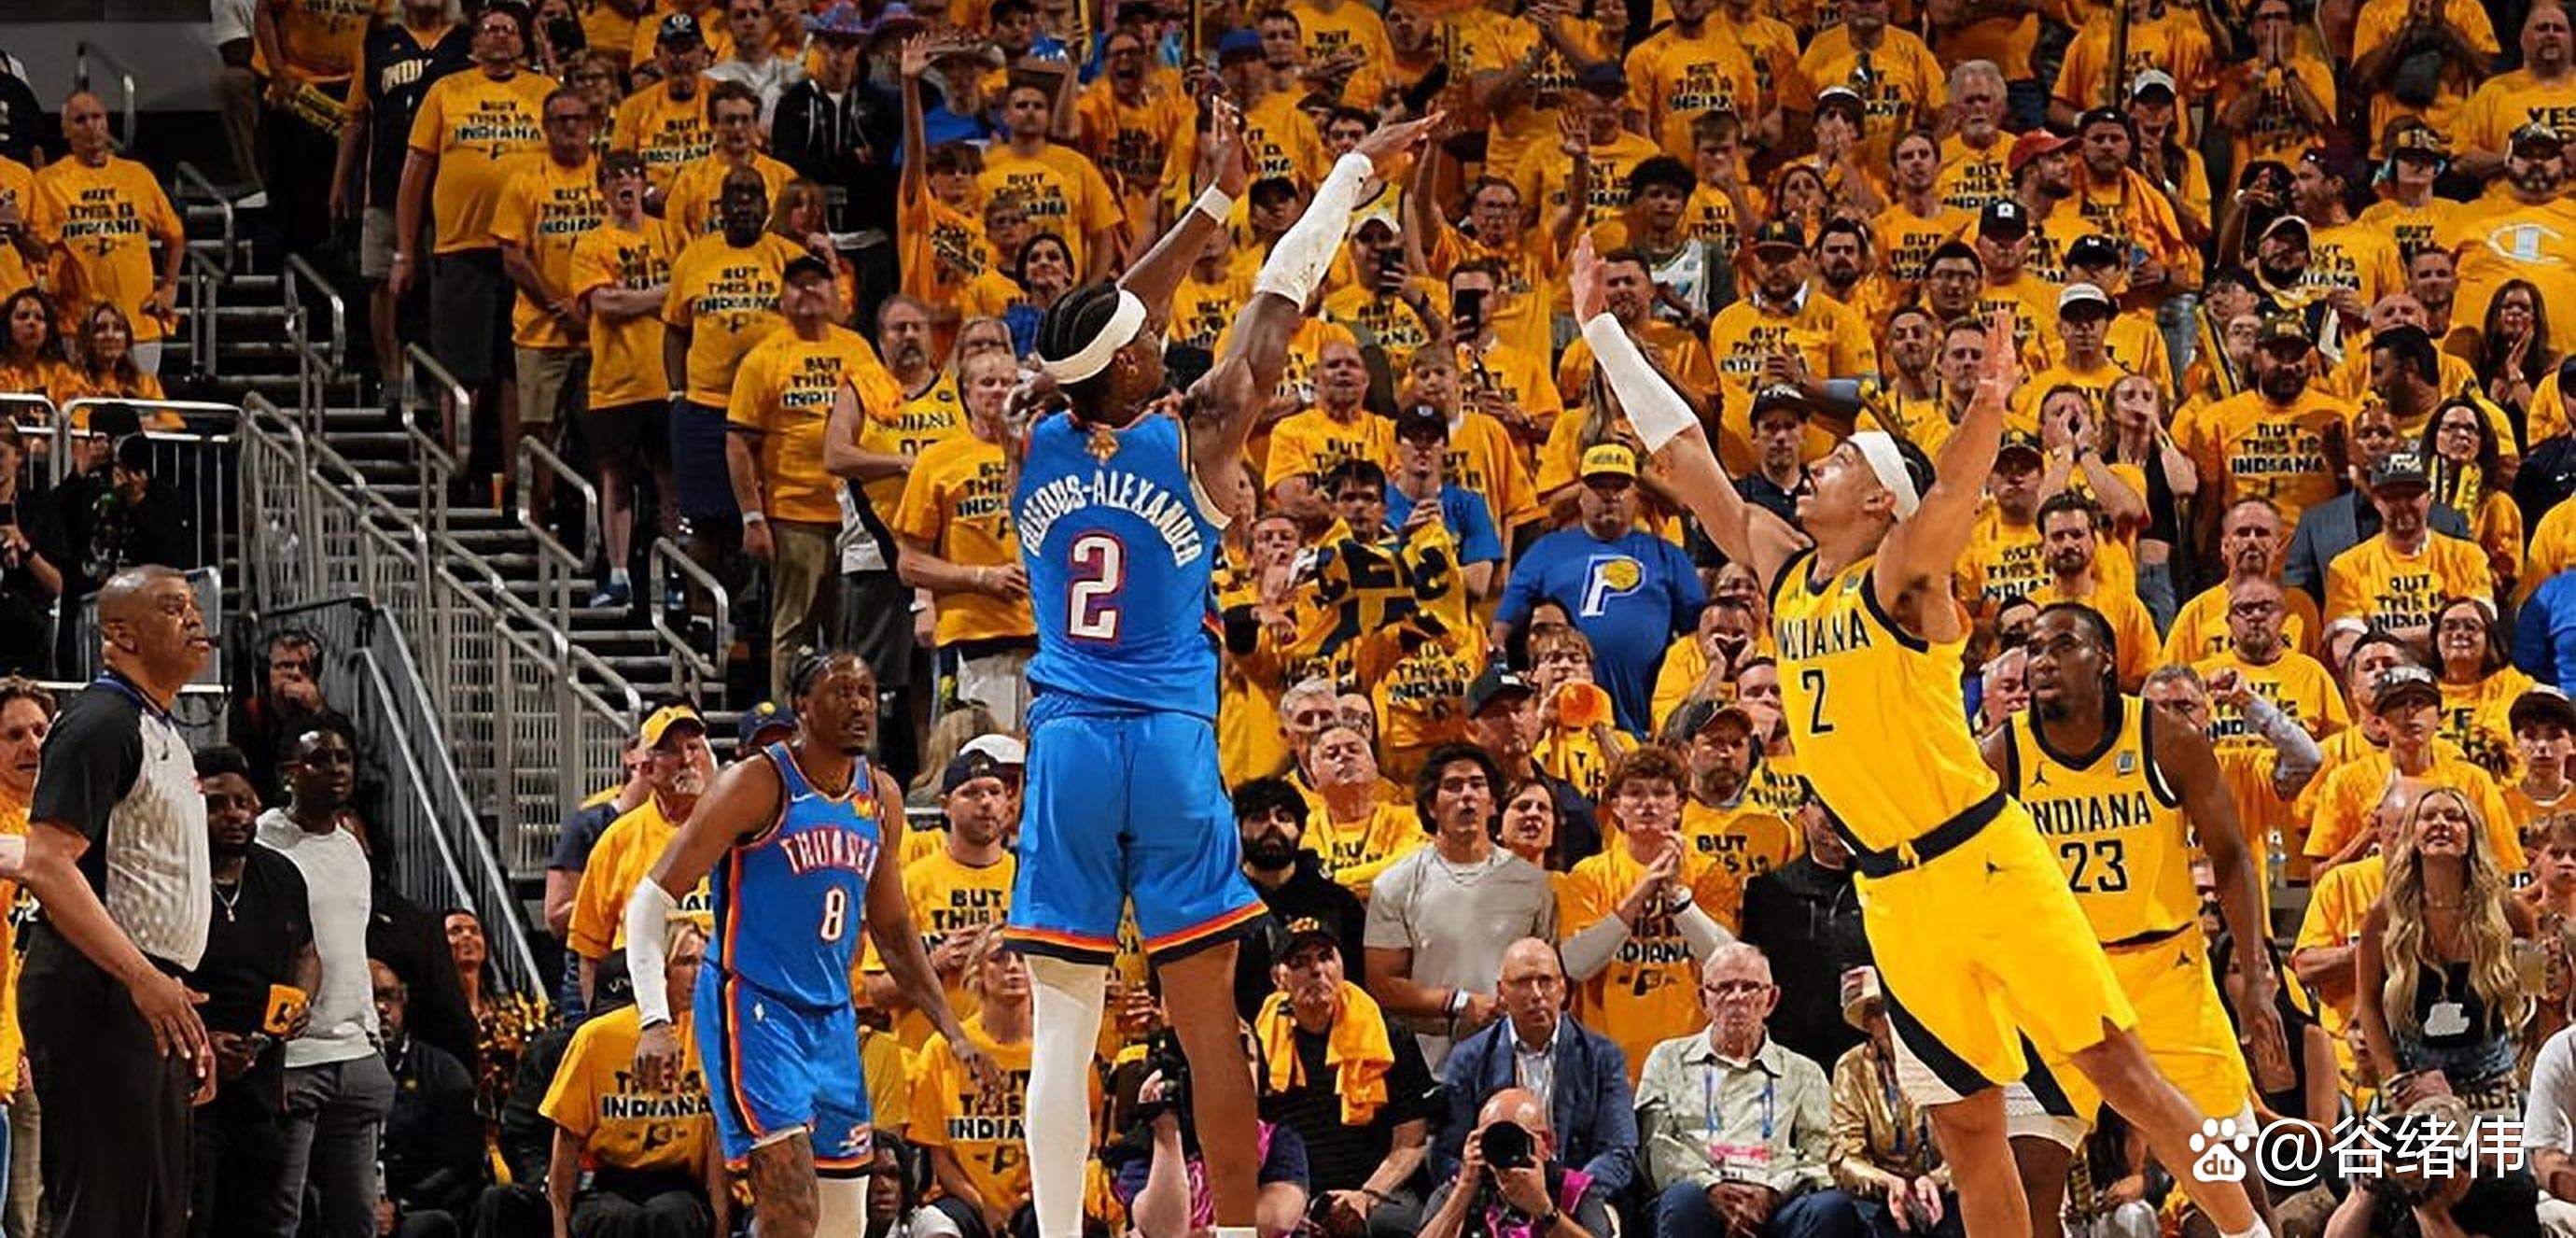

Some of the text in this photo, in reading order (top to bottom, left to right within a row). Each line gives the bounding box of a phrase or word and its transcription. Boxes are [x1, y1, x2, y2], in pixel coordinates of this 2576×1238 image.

[2232, 457, 2324, 474] INDIANA
[1069, 533, 1124, 641] 2
[1802, 668, 1834, 734] 2
[2023, 790, 2152, 838] NDIANA
[1697, 835, 1747, 853] BUT
[2060, 837, 2129, 893] 23
[820, 887, 847, 942] 8
[951, 888, 1002, 907] BUT
[1616, 940, 1691, 964] DIANA
[603, 1094, 712, 1118] INDIANA
